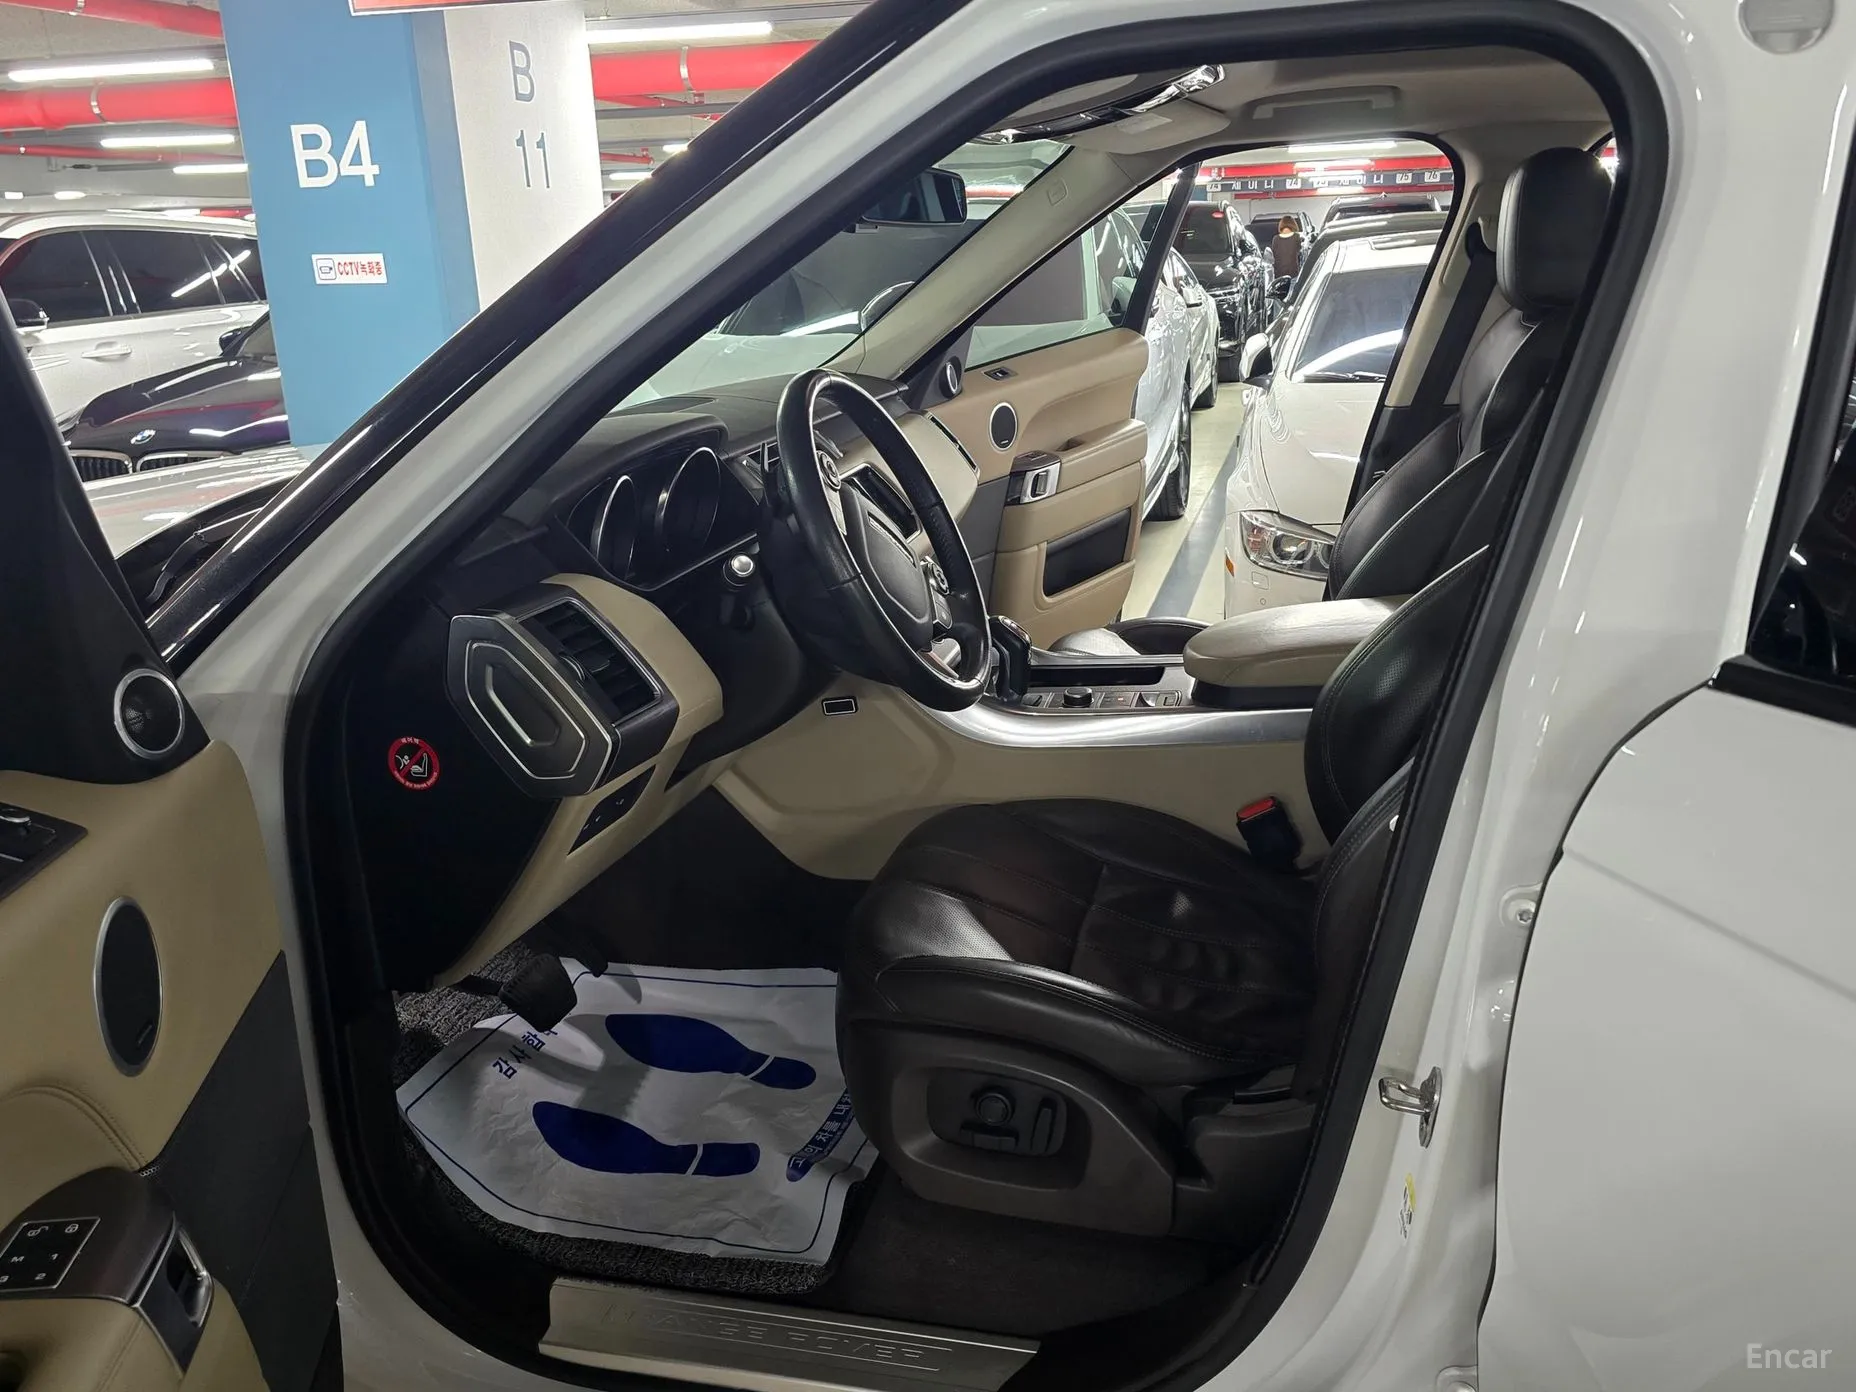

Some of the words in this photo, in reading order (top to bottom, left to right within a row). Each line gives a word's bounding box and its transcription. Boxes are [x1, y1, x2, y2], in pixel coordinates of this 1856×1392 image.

[508, 40, 535, 103] B
[290, 120, 380, 189] B4
[515, 129, 553, 189] 11
